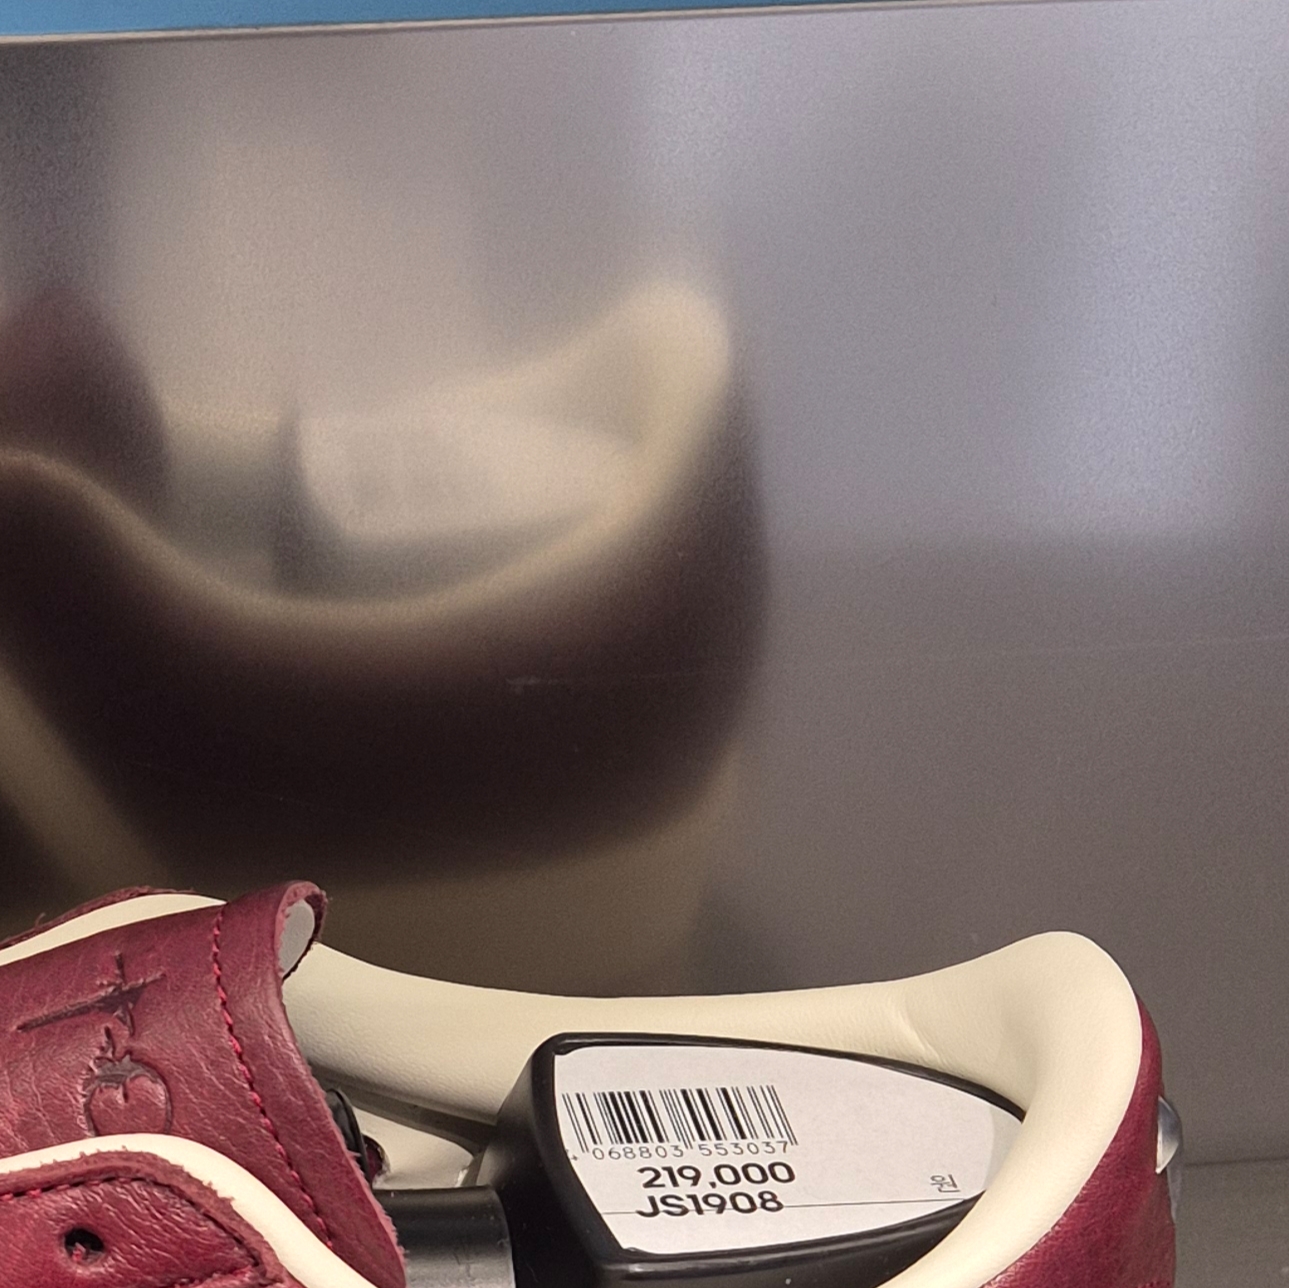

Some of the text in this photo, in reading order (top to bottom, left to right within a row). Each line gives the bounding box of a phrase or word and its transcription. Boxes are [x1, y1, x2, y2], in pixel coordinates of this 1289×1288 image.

[592, 1145, 685, 1161] 068803
[698, 1140, 790, 1157] 553037
[636, 1161, 796, 1189] 219,000
[930, 1174, 961, 1193] 원
[635, 1191, 785, 1218] JS1908
